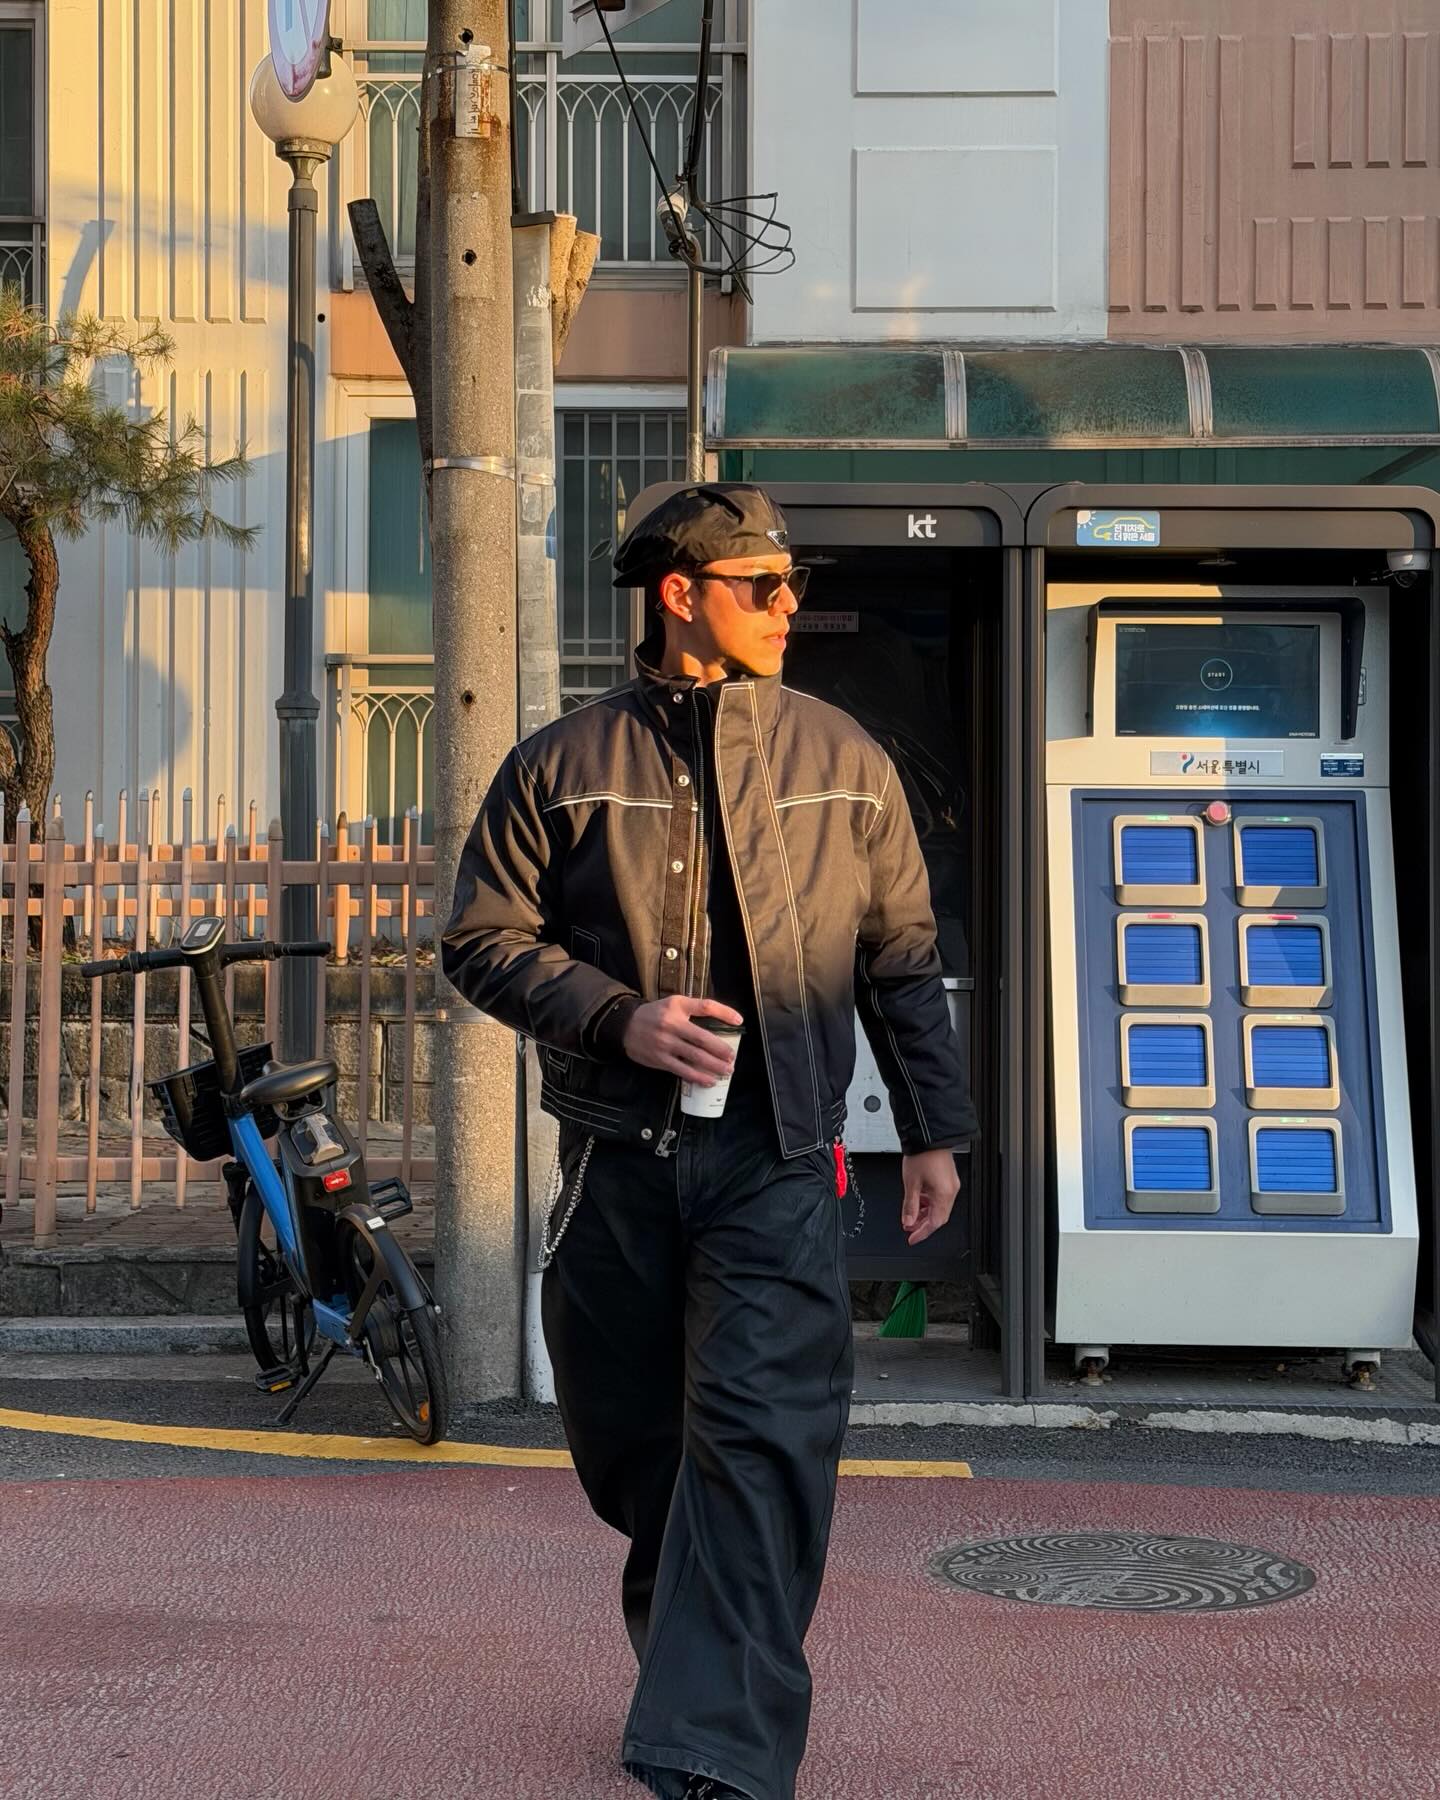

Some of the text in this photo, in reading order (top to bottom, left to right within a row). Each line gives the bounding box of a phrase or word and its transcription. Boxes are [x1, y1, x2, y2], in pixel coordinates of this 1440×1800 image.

[908, 514, 937, 538] kt
[1114, 524, 1145, 533] 전기차로
[1114, 532, 1122, 541] 더
[1197, 759, 1260, 774] 서울특별시
